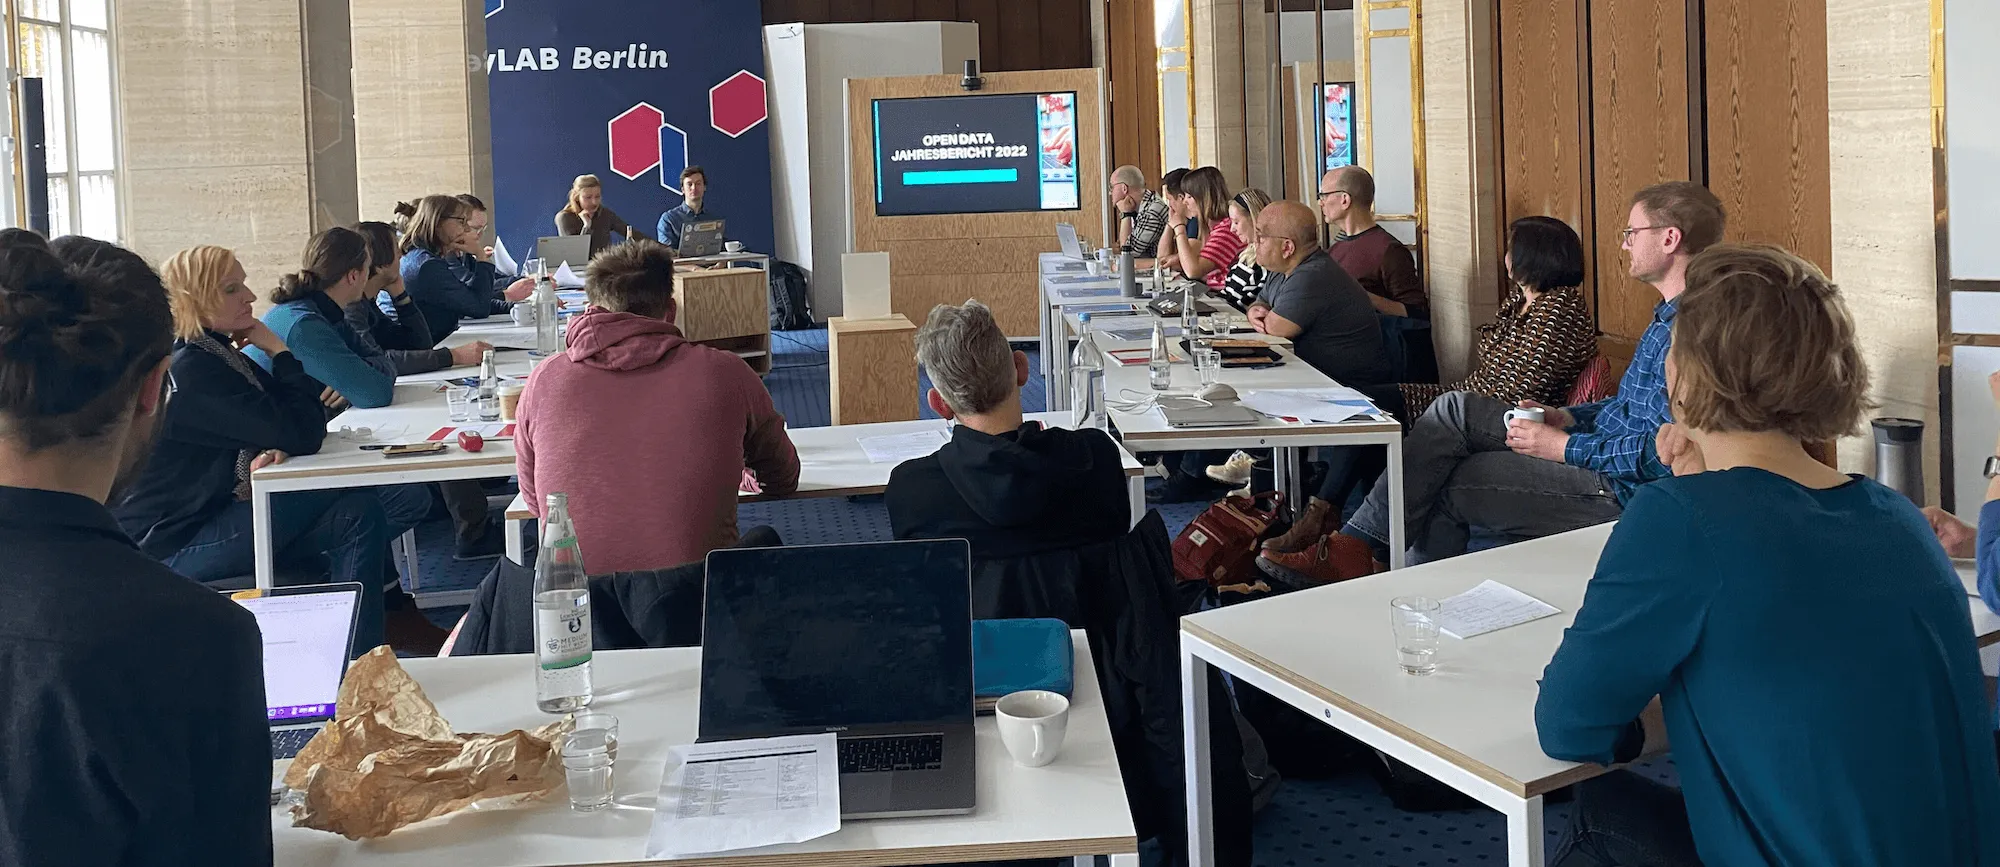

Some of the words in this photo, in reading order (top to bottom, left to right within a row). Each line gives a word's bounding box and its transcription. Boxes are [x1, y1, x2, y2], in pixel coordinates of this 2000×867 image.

[572, 42, 669, 70] Berlin
[922, 133, 958, 146] OPEN
[958, 132, 995, 145] DATA
[891, 147, 994, 161] JAHRESBERICHT
[995, 144, 1028, 158] 2022
